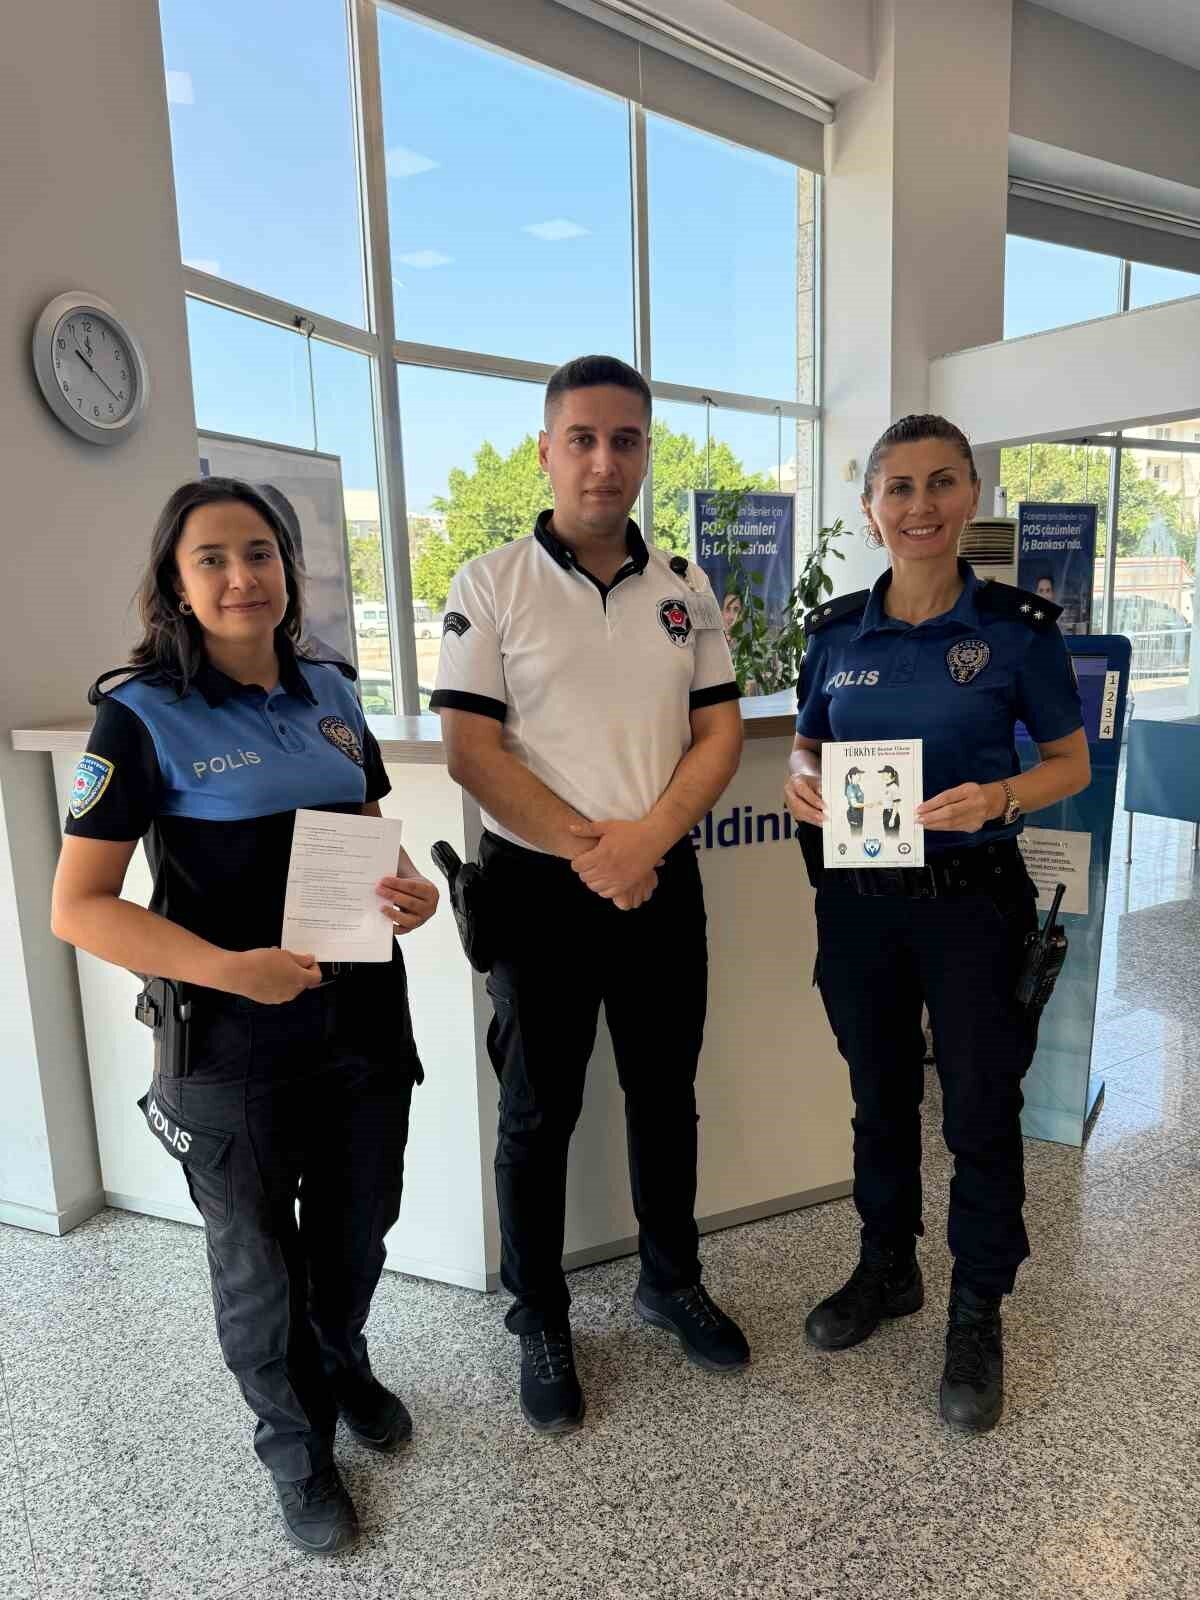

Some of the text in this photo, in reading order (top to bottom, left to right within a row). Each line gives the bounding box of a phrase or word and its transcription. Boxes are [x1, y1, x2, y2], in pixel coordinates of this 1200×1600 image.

[67, 323, 76, 337] 11
[82, 321, 92, 333] 12
[57, 338, 66, 350] 10
[114, 349, 121, 361] 2
[120, 369, 127, 381] 3
[77, 398, 83, 409] 7
[93, 405, 100, 417] 6
[1022, 524, 1040, 536] POS
[1108, 674, 1116, 685] 1
[1106, 691, 1114, 702] 2
[1104, 707, 1112, 718] 3
[1103, 725, 1110, 736] 4
